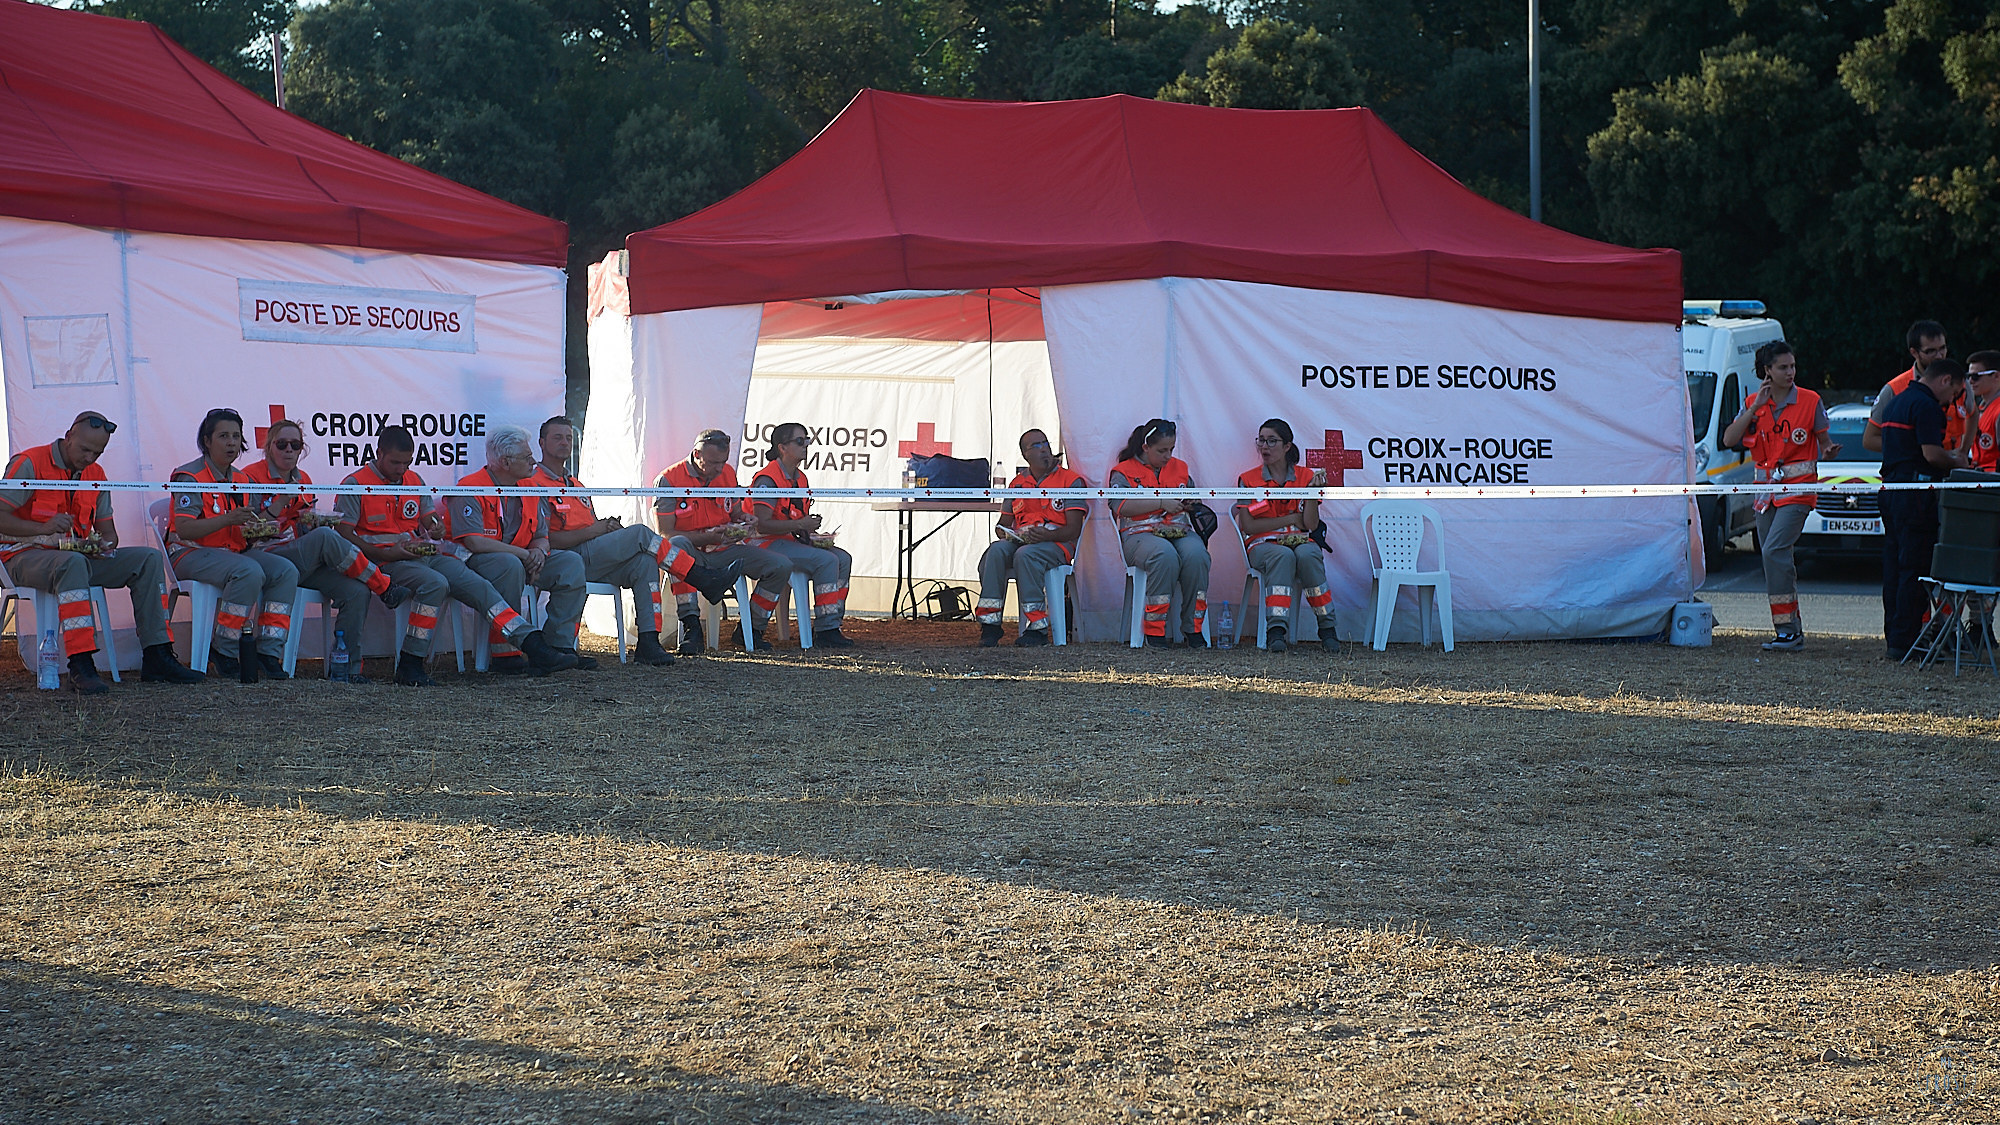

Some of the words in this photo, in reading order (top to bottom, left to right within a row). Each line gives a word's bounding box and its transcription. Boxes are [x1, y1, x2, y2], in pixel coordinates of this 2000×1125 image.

[255, 299, 328, 325] POSTE
[331, 305, 362, 326] DE
[366, 305, 461, 333] SECOURS
[1683, 347, 1705, 355] AISE
[1301, 364, 1389, 389] POSTE
[1395, 365, 1430, 388] DE
[1437, 364, 1557, 392] SECOURS
[311, 412, 486, 437] CROIXROUGE
[328, 442, 468, 467] FRAAISE
[1367, 437, 1553, 460] CROIX-ROUGE
[1384, 462, 1529, 487] FRANÇAISE
